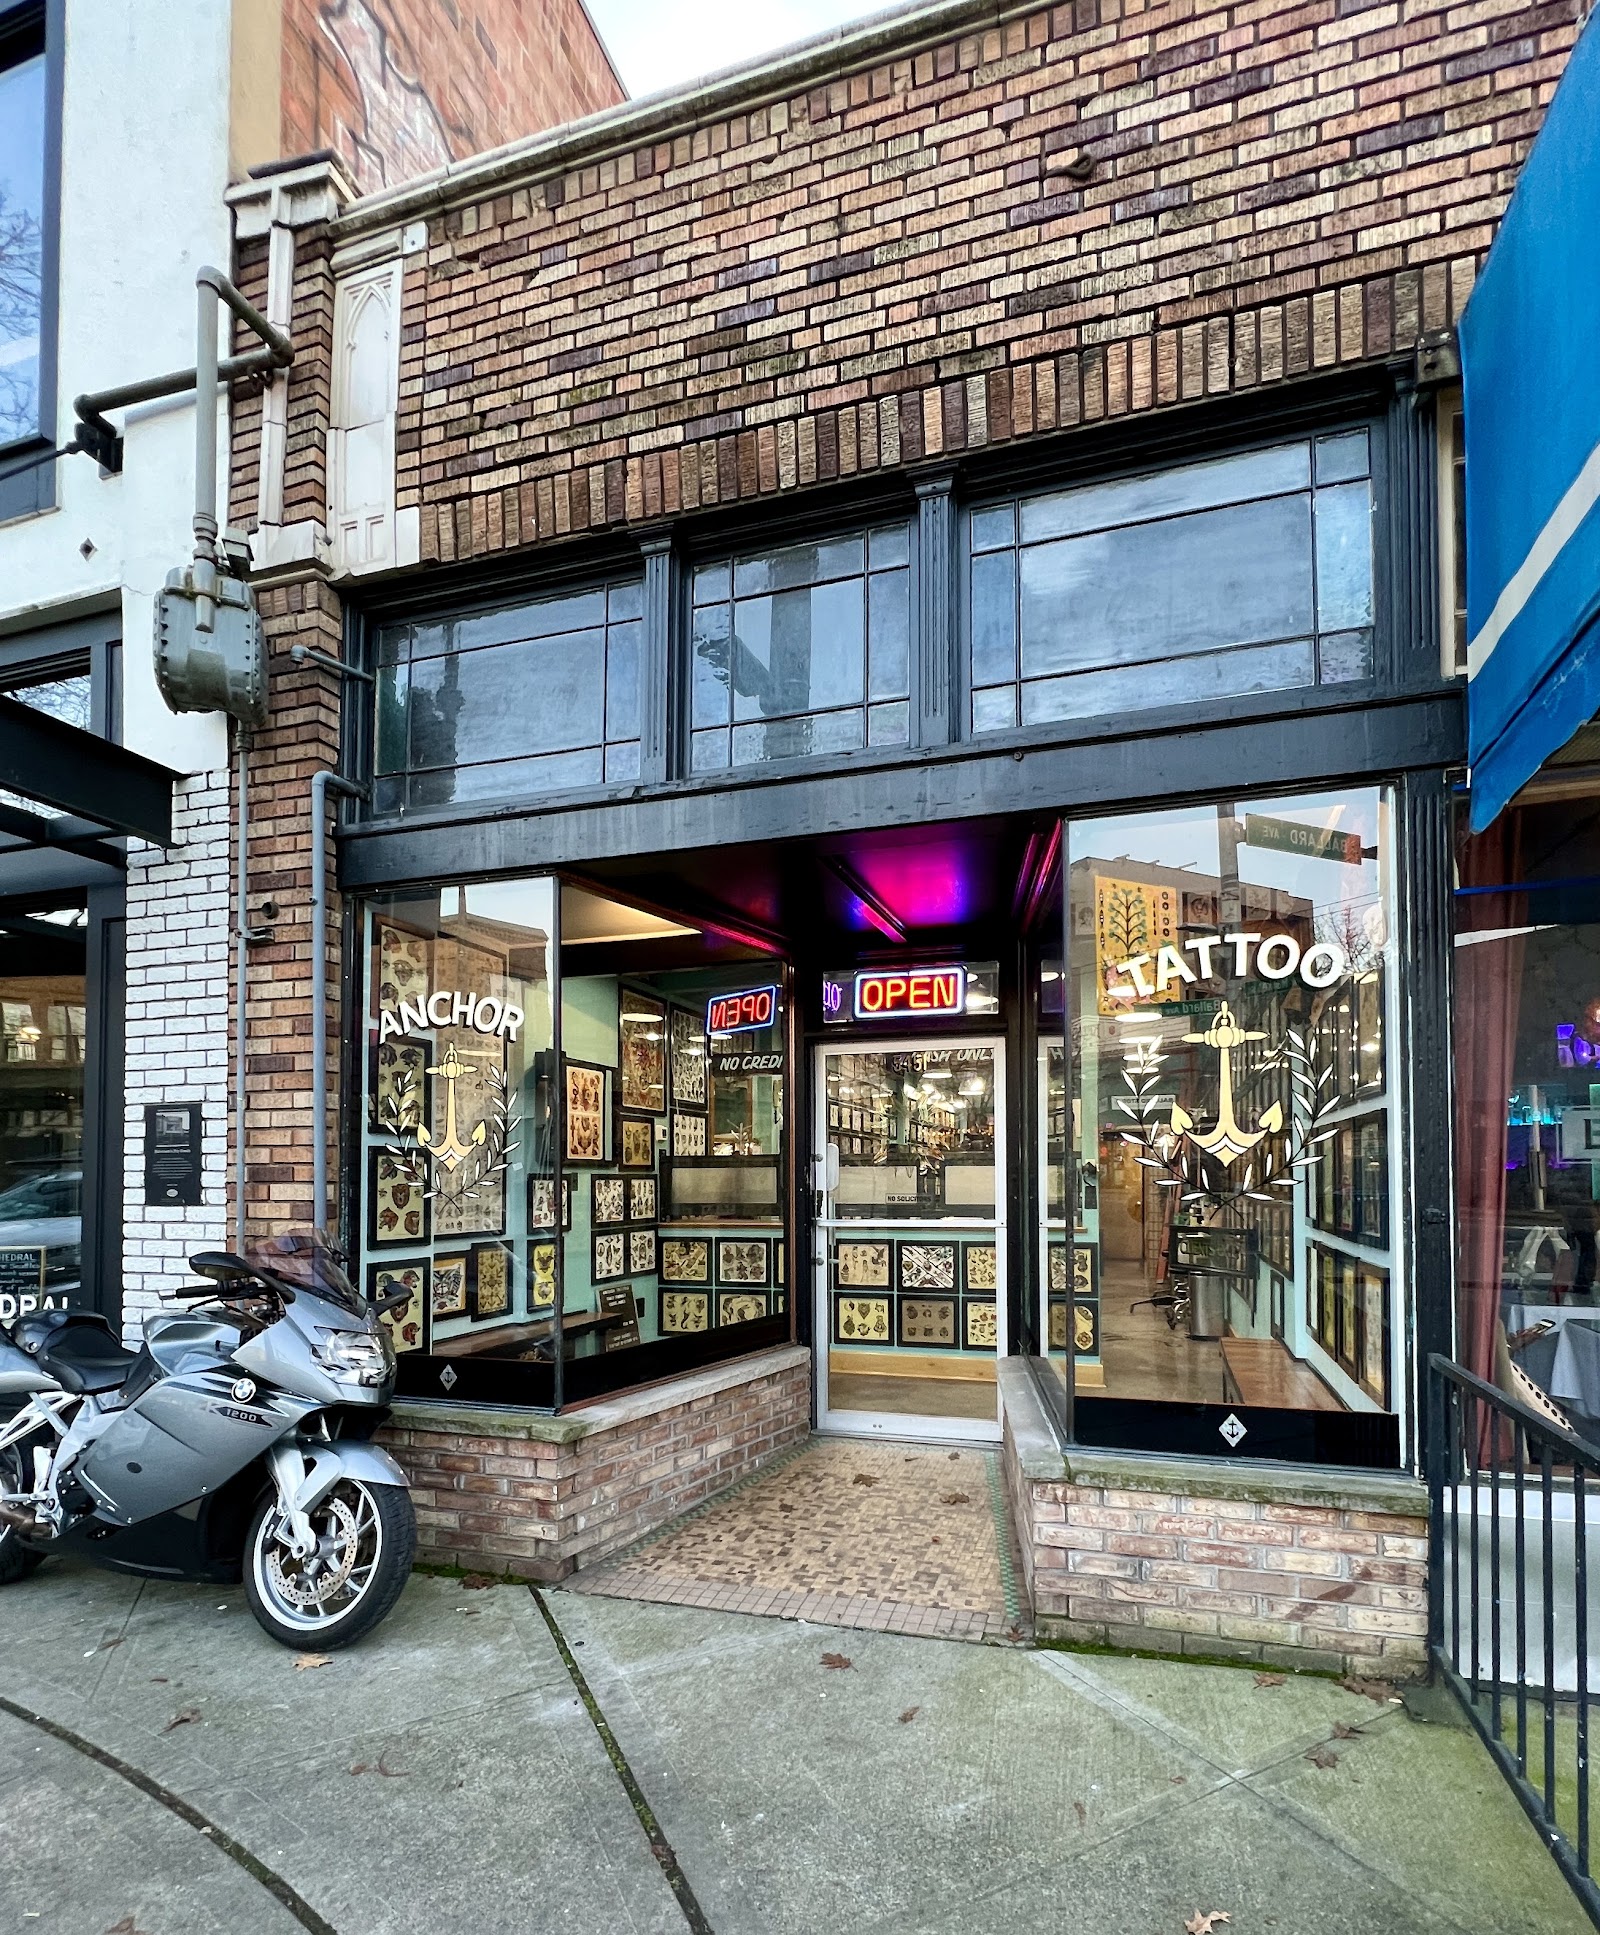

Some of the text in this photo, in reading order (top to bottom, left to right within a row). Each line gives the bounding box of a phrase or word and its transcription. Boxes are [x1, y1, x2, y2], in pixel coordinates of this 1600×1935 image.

[1116, 932, 1345, 998] TATTOO
[862, 975, 956, 1012] OPEN
[379, 990, 525, 1045] ANCHOR
[720, 1056, 740, 1071] NO
[226, 1408, 257, 1422] 1200
